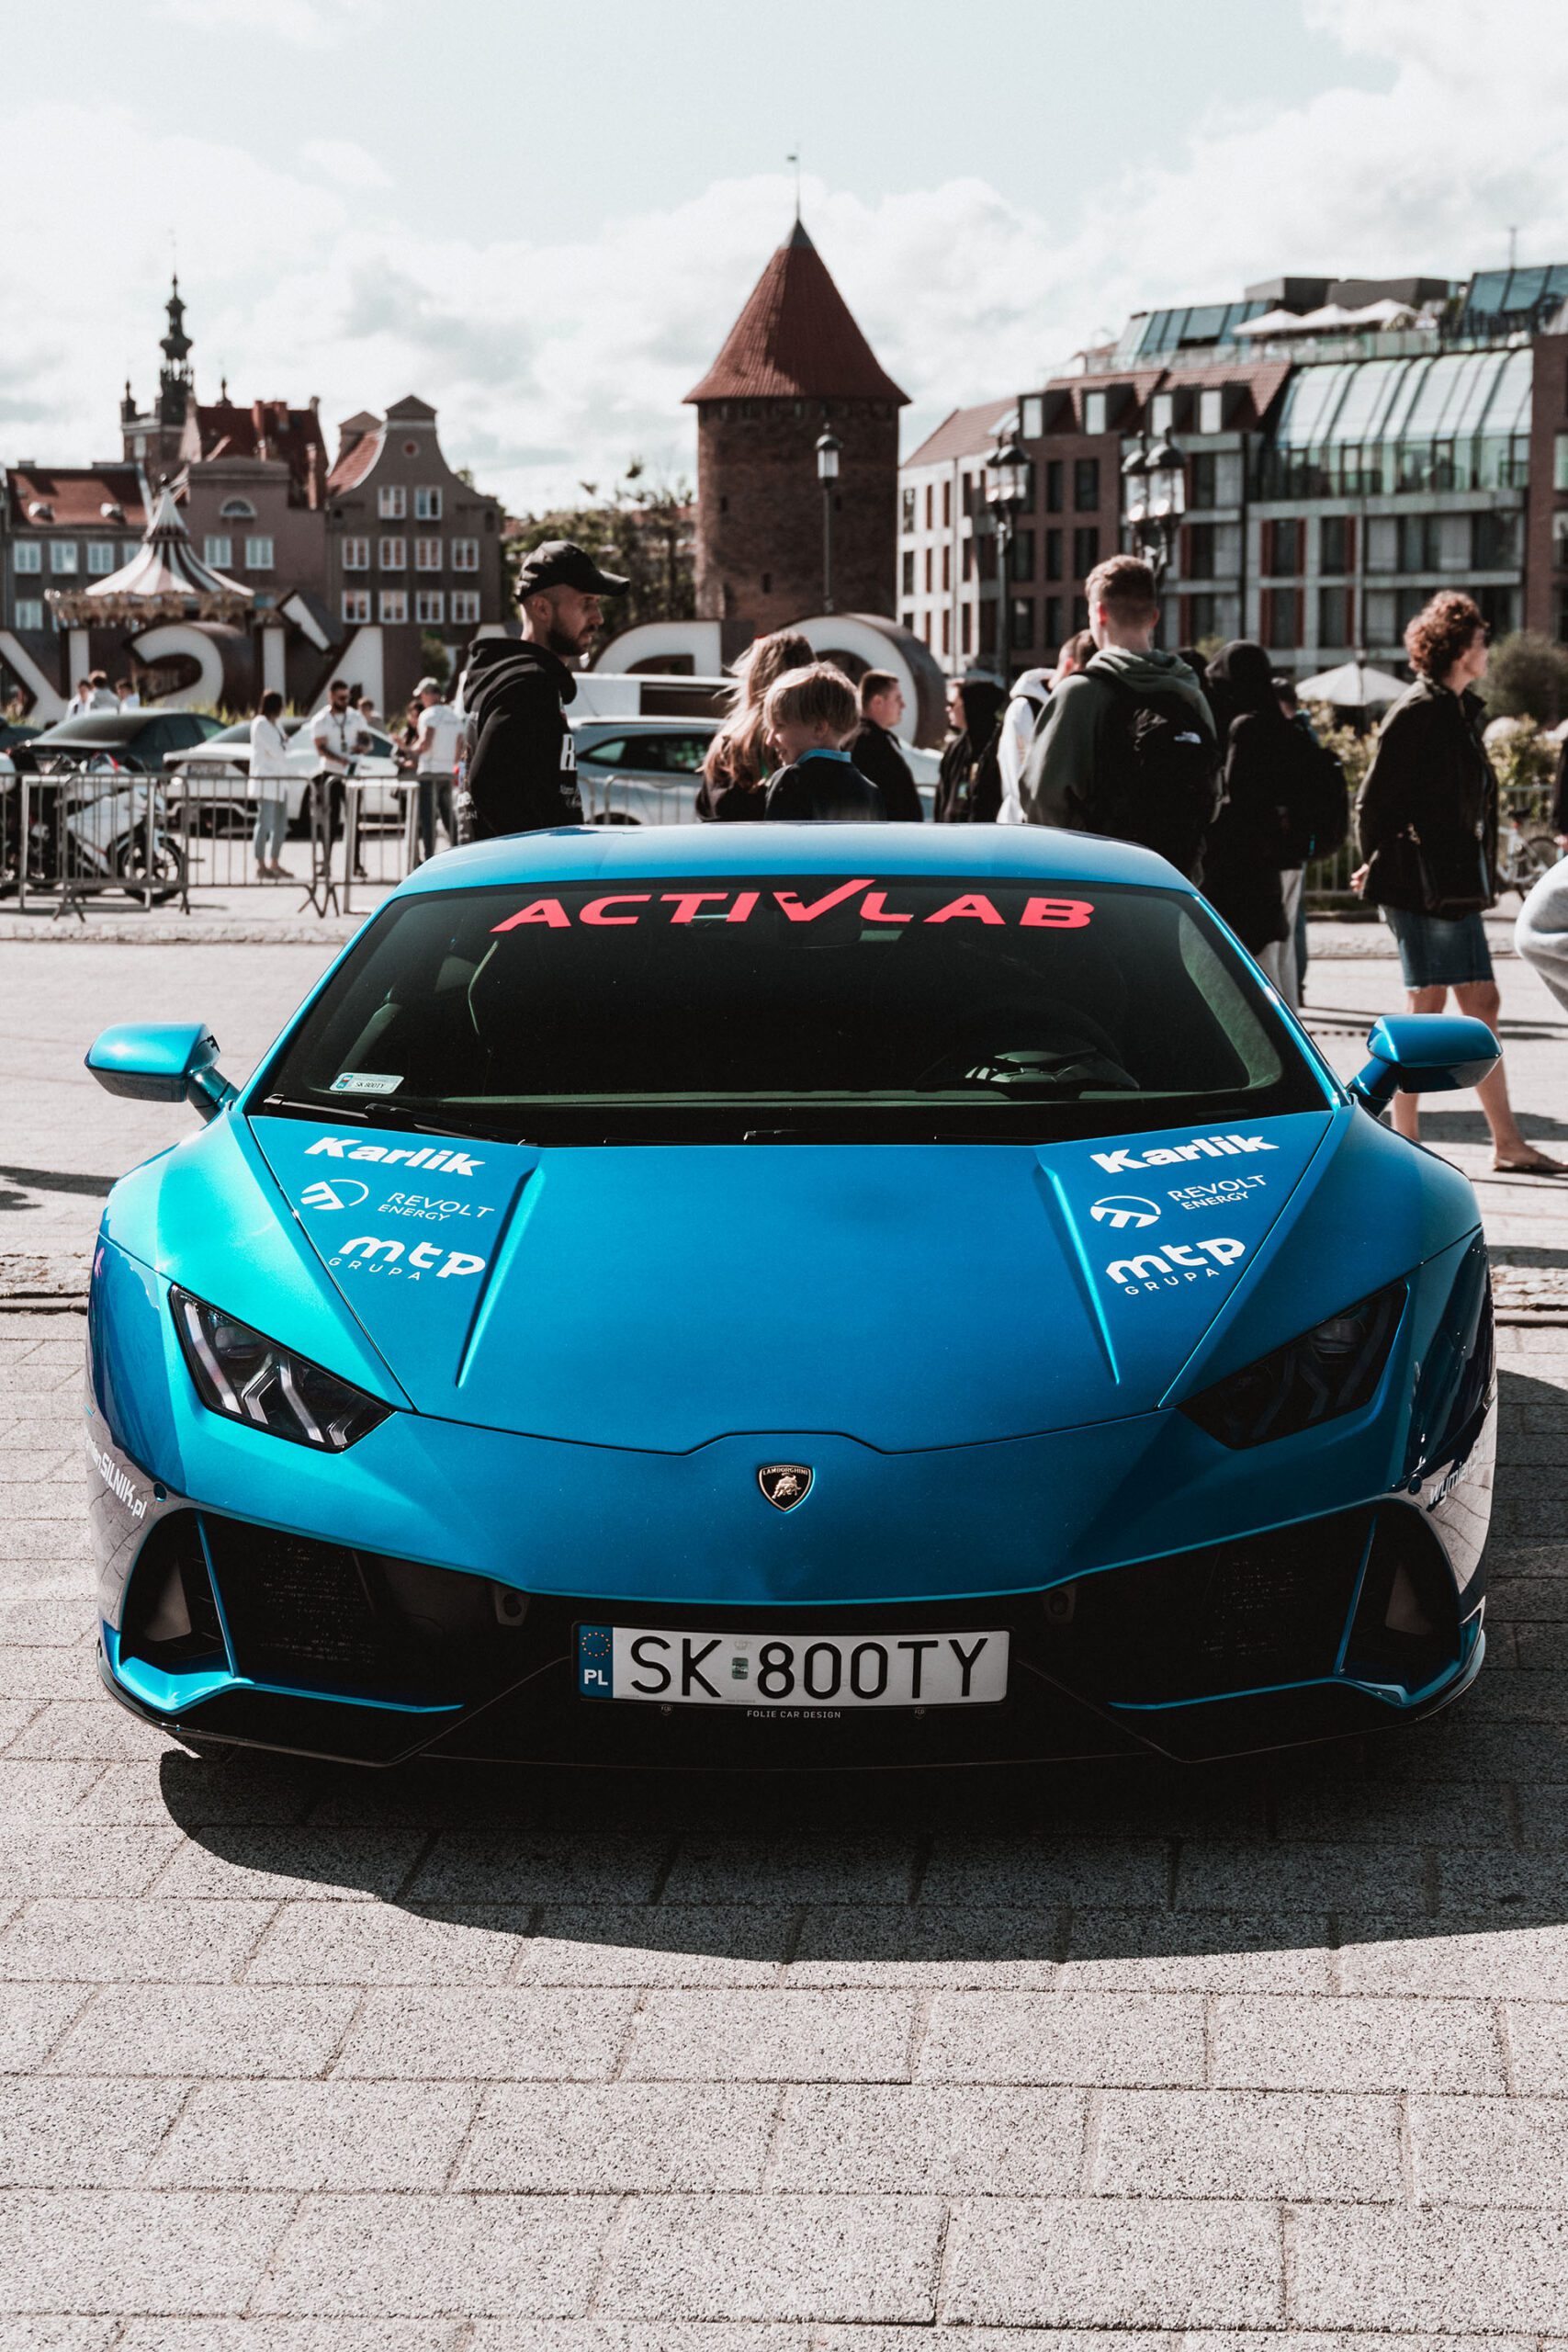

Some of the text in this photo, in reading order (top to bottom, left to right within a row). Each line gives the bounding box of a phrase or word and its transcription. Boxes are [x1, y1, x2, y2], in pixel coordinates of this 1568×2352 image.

[491, 879, 1095, 933] ACTIVLAB
[304, 1136, 485, 1176] Karlik
[1089, 1135, 1280, 1173] Karlik
[1168, 1175, 1267, 1202] REVOLT
[1180, 1191, 1249, 1210] ENERGY
[378, 1204, 450, 1221] ENERGY
[387, 1192, 495, 1217] REVOLT
[328, 1257, 421, 1281] GRUPA
[338, 1236, 486, 1278] mtp
[1105, 1238, 1246, 1283] mtp
[1124, 1267, 1220, 1295] GRUPA
[762, 1467, 808, 1476] LAMBORGHINI
[583, 1668, 609, 1686] PL
[630, 1635, 988, 1700] SK 800TY
[747, 1710, 777, 1718] FOLIE
[803, 1711, 841, 1719] DESIGN
